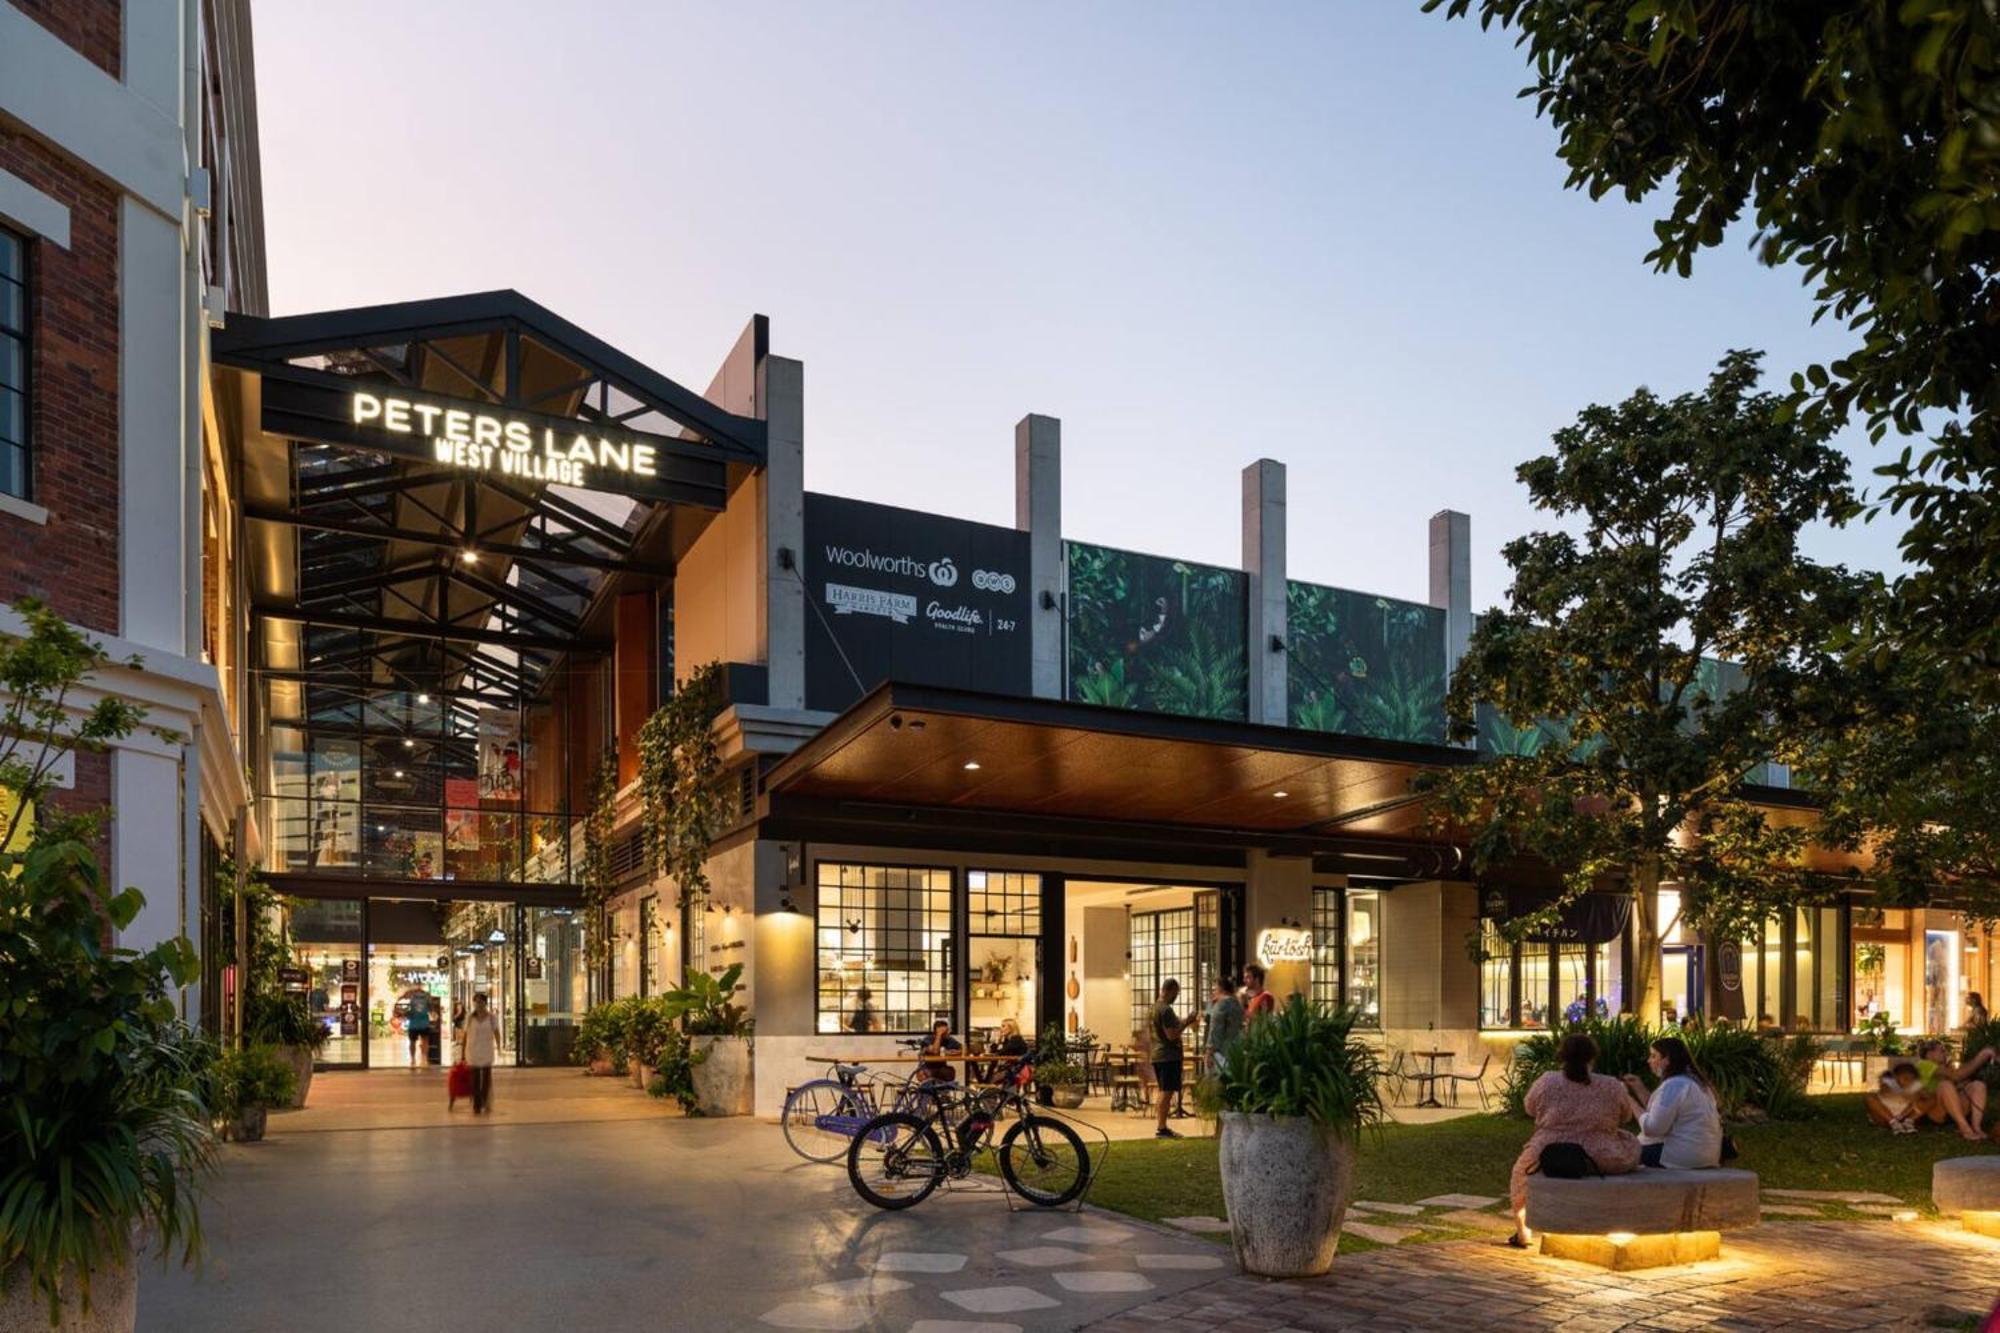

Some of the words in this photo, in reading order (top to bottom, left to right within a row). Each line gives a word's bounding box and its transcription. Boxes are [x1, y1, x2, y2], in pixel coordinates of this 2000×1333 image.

[353, 392, 533, 453] PETERS
[545, 428, 658, 476] LANE
[435, 437, 495, 470] WEST
[501, 449, 585, 487] VILLAGE
[825, 545, 926, 578] Woolworths
[926, 601, 983, 625] Goodlife
